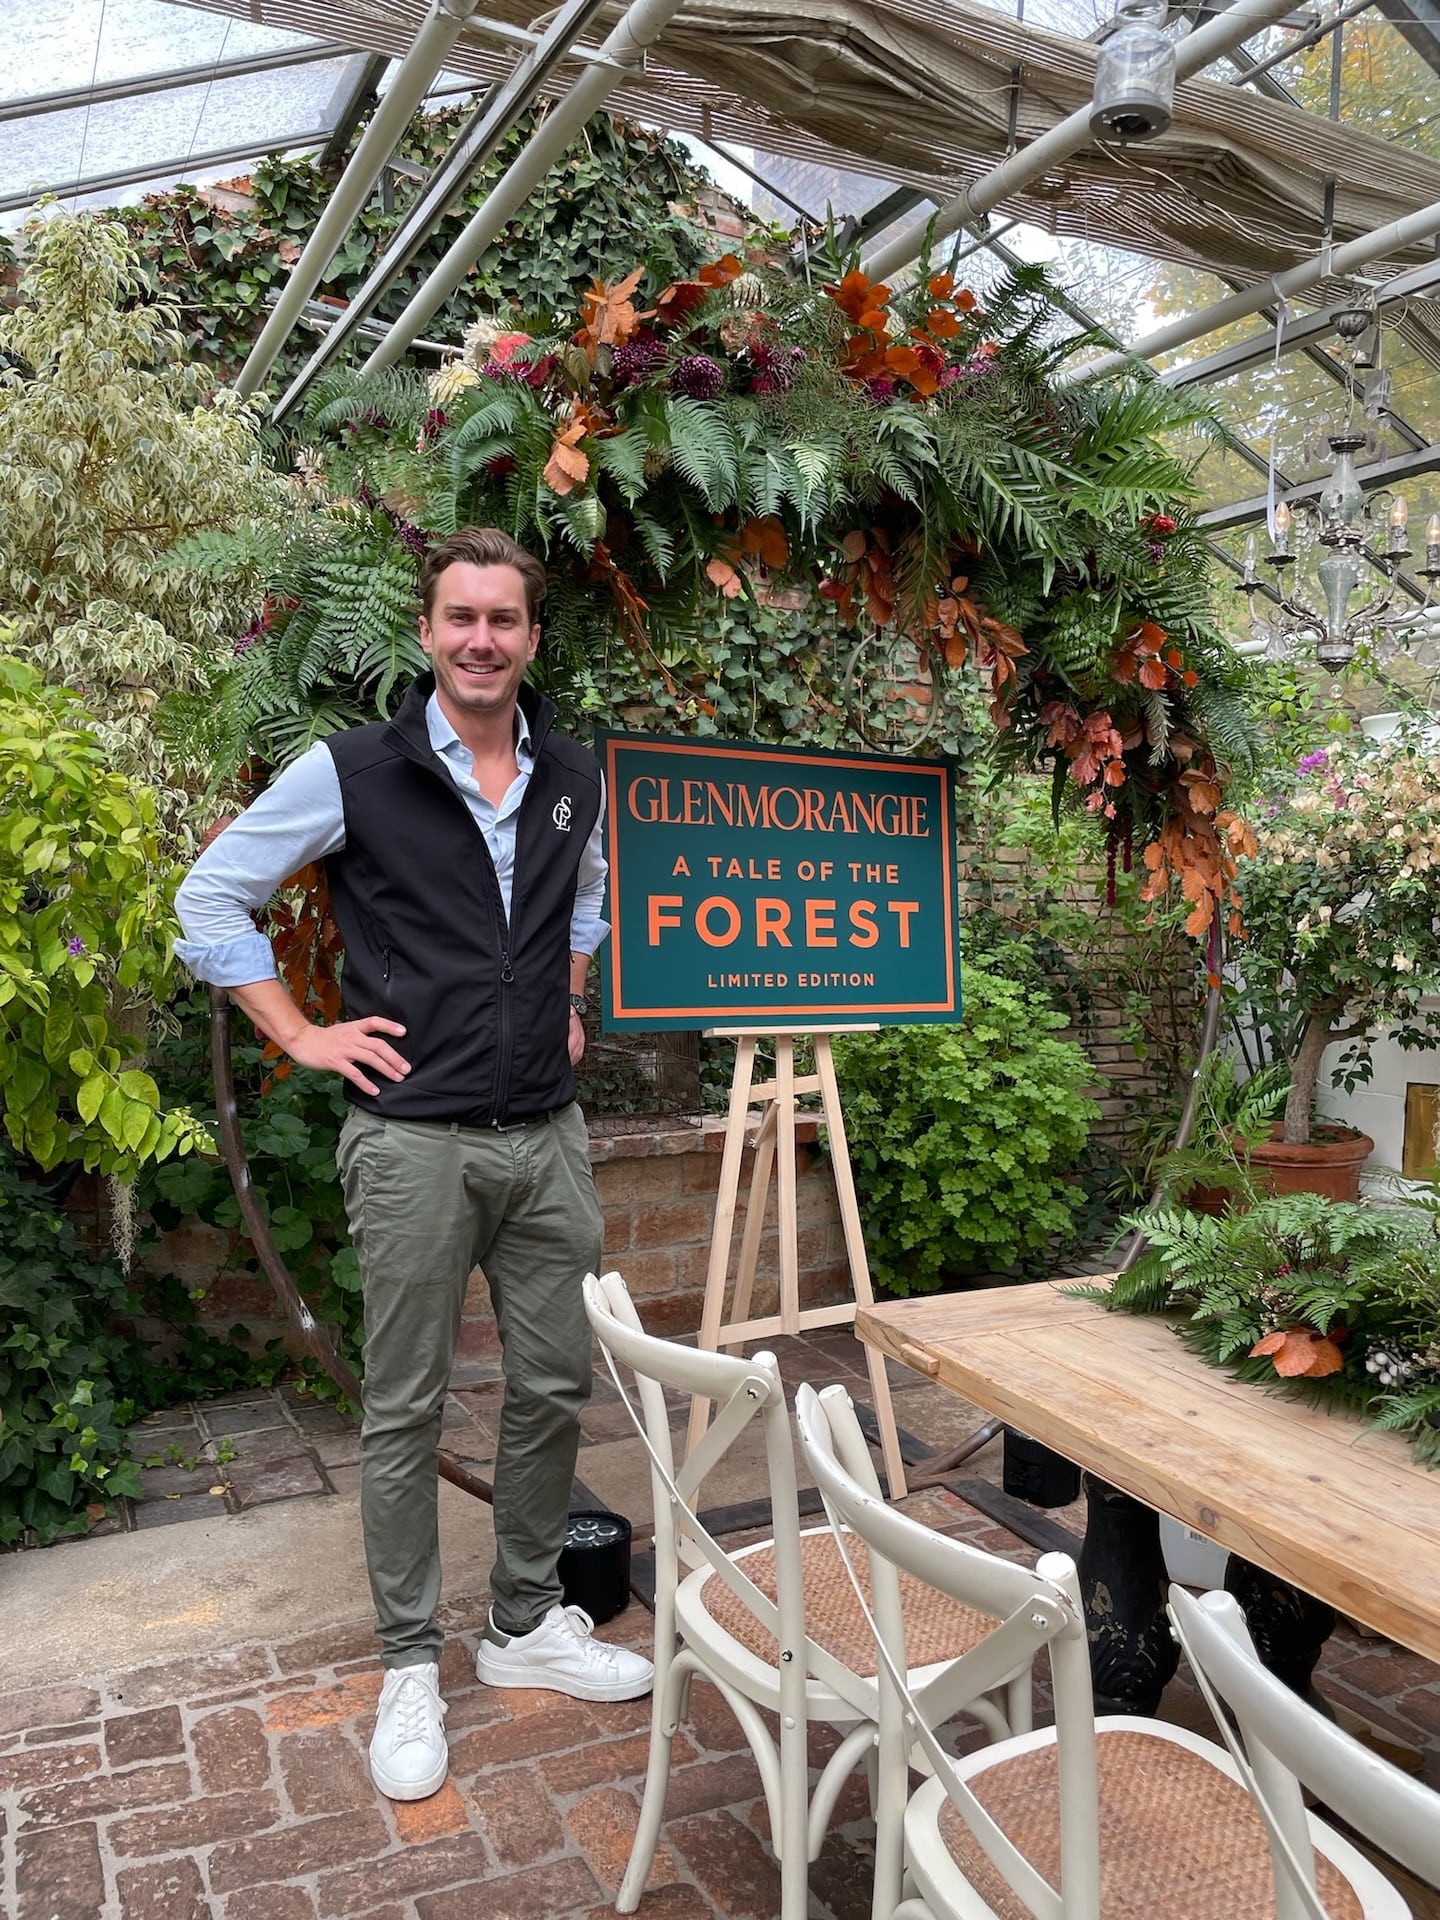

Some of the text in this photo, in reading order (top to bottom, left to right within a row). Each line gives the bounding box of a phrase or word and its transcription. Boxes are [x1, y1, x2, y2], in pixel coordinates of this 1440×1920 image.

[627, 776, 930, 838] GLENMORANGIE
[672, 855, 899, 884] A TALE OF THE
[648, 895, 920, 949] FOREST
[708, 973, 875, 988] LIMITED EDITION
